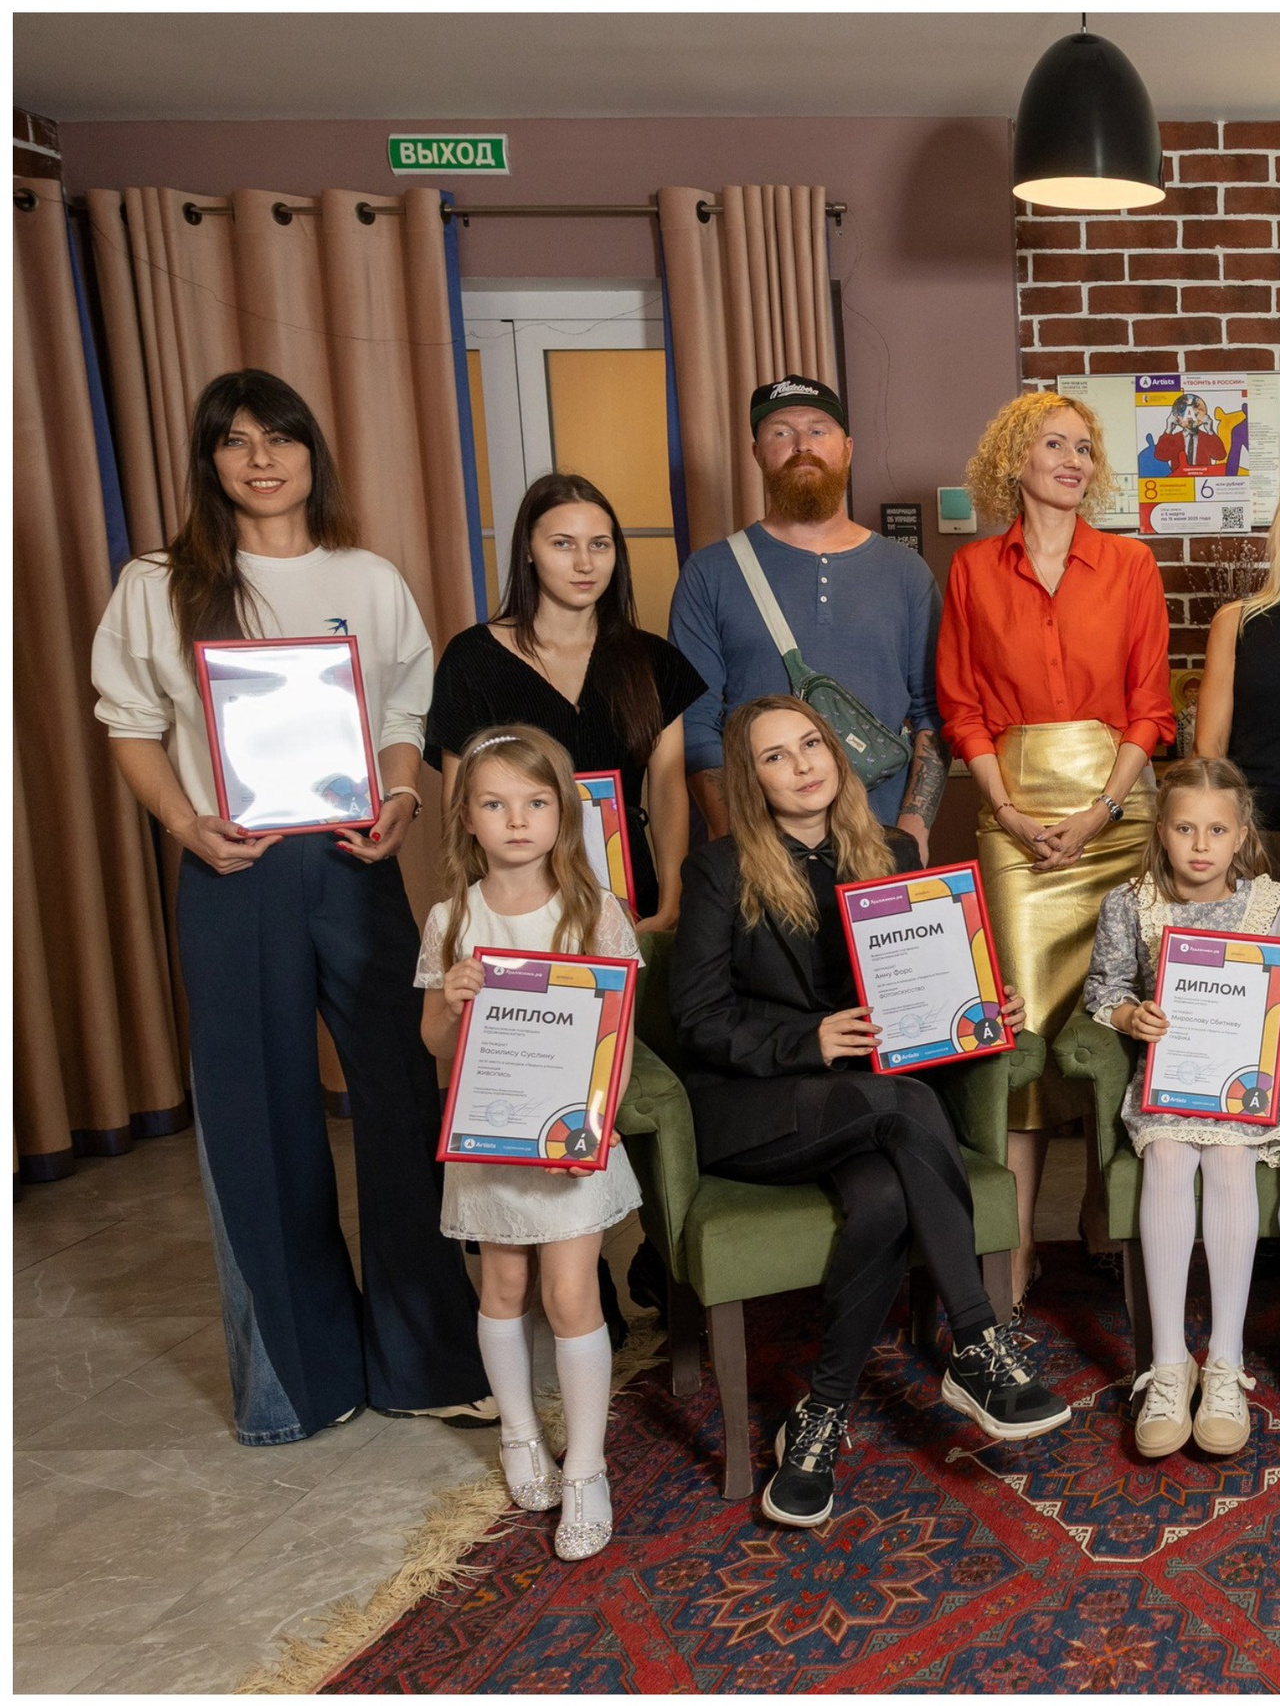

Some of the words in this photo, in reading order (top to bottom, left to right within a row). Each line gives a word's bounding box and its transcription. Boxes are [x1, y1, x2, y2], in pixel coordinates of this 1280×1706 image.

[400, 142, 496, 166] ВЫХОД
[1144, 480, 1158, 500] 8
[1201, 479, 1214, 499] 6
[868, 922, 945, 950] ДИПЛОМ
[893, 968, 913, 976] Форс
[1174, 979, 1246, 997] ДИПЛОМ
[486, 1005, 574, 1026] ДИПЛОМ
[480, 1047, 520, 1058] Василису
[901, 1051, 920, 1060] Artists
[475, 1141, 497, 1149] Artists
